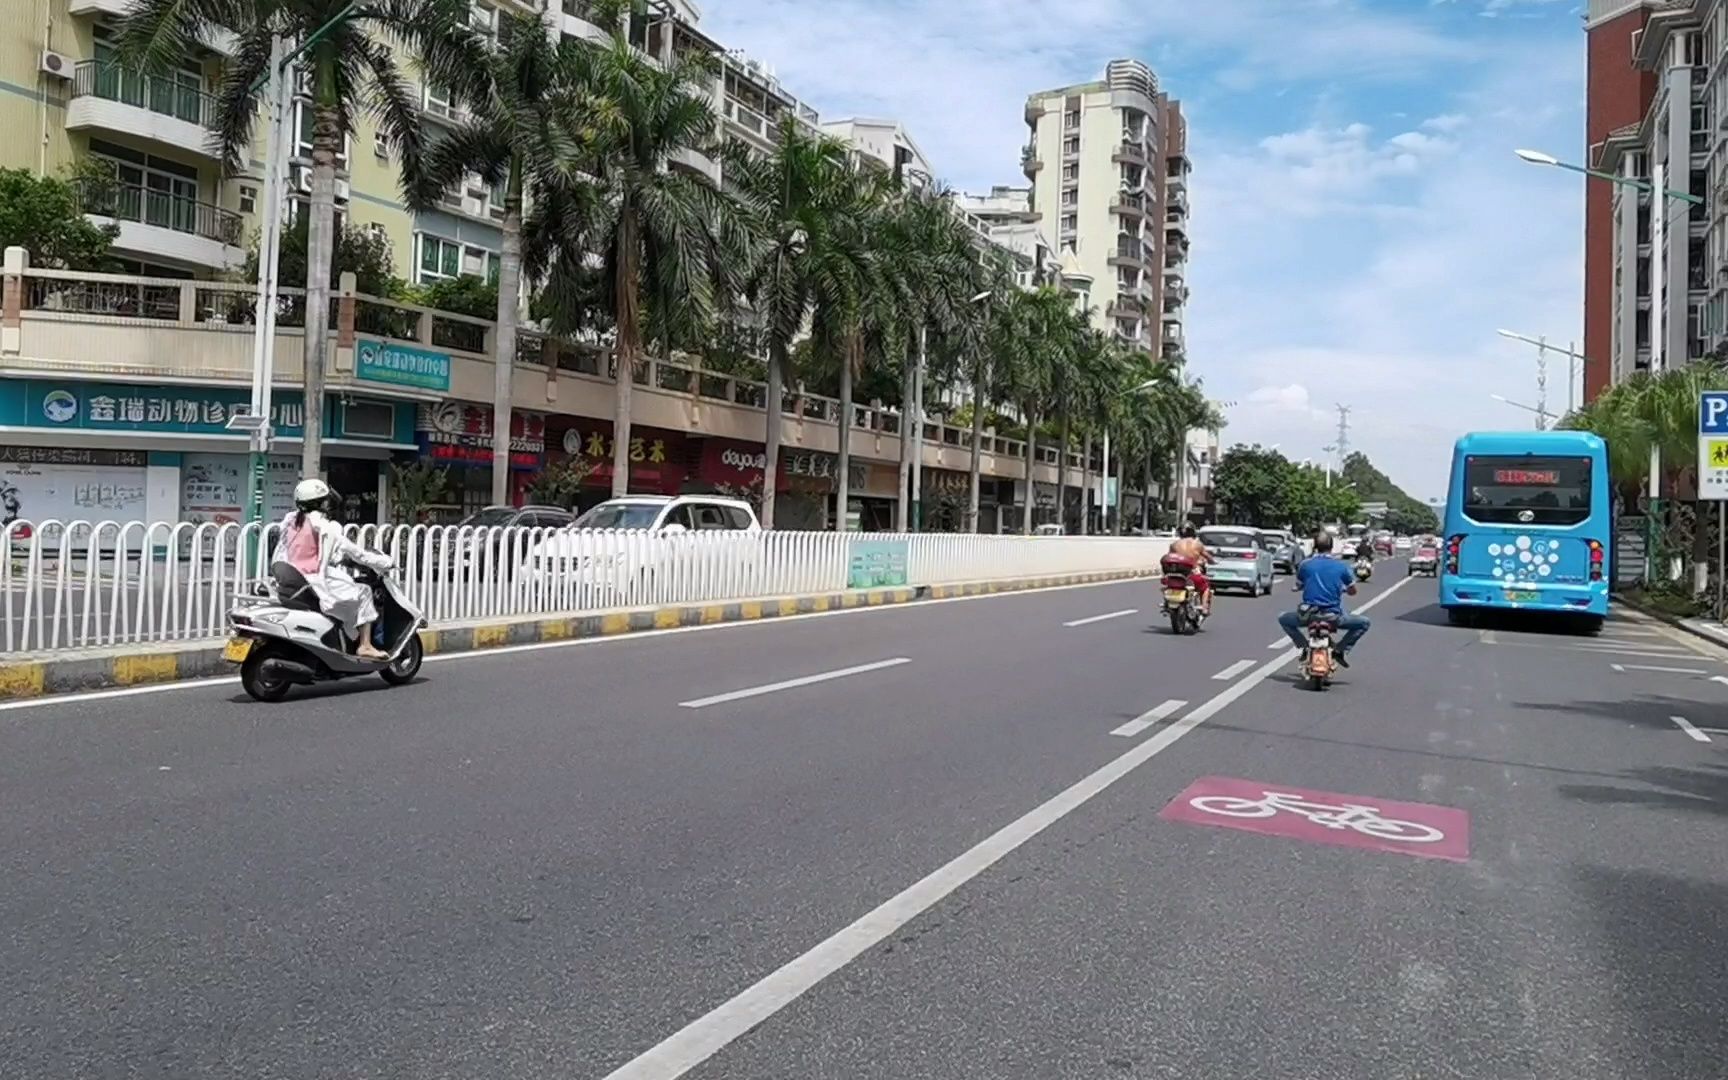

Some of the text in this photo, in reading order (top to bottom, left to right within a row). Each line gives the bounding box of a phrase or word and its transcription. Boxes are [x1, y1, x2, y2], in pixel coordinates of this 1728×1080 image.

[89, 395, 303, 427] 鑫瑞动物诊心
[1705, 397, 1727, 427] P
[585, 431, 665, 463] 水艺术
